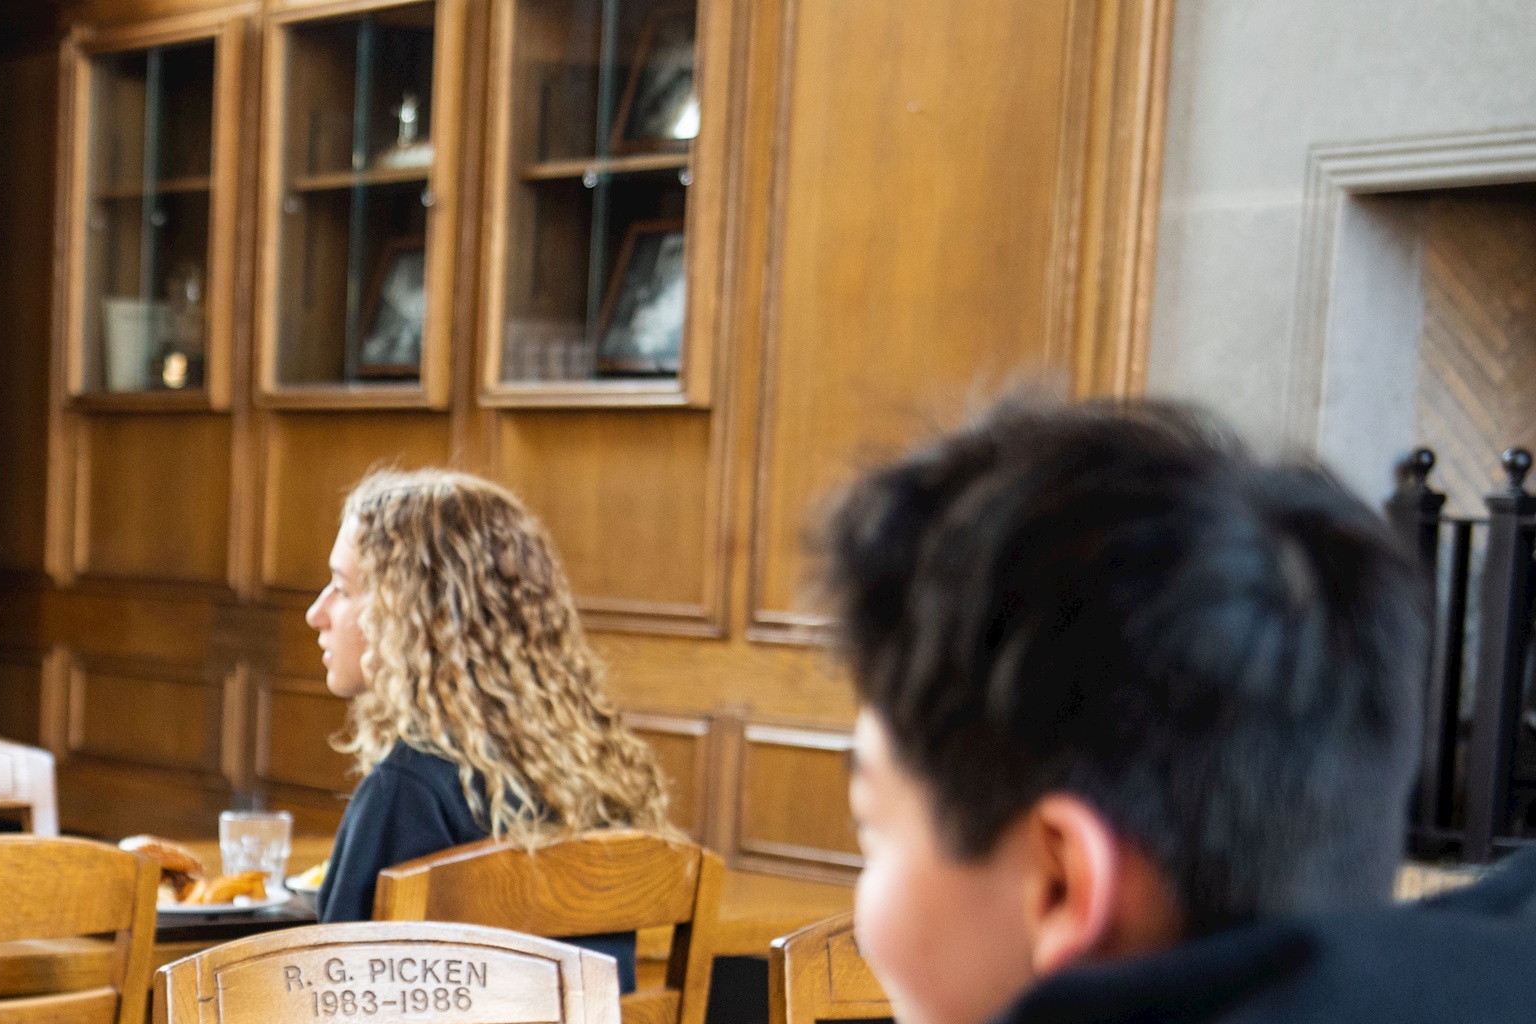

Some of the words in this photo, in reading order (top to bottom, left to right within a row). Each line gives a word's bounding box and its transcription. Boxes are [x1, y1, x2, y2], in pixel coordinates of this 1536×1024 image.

[283, 965, 313, 992] R.
[324, 957, 354, 984] G.
[368, 957, 487, 988] PICKEN
[313, 986, 472, 1017] 1983-1986
